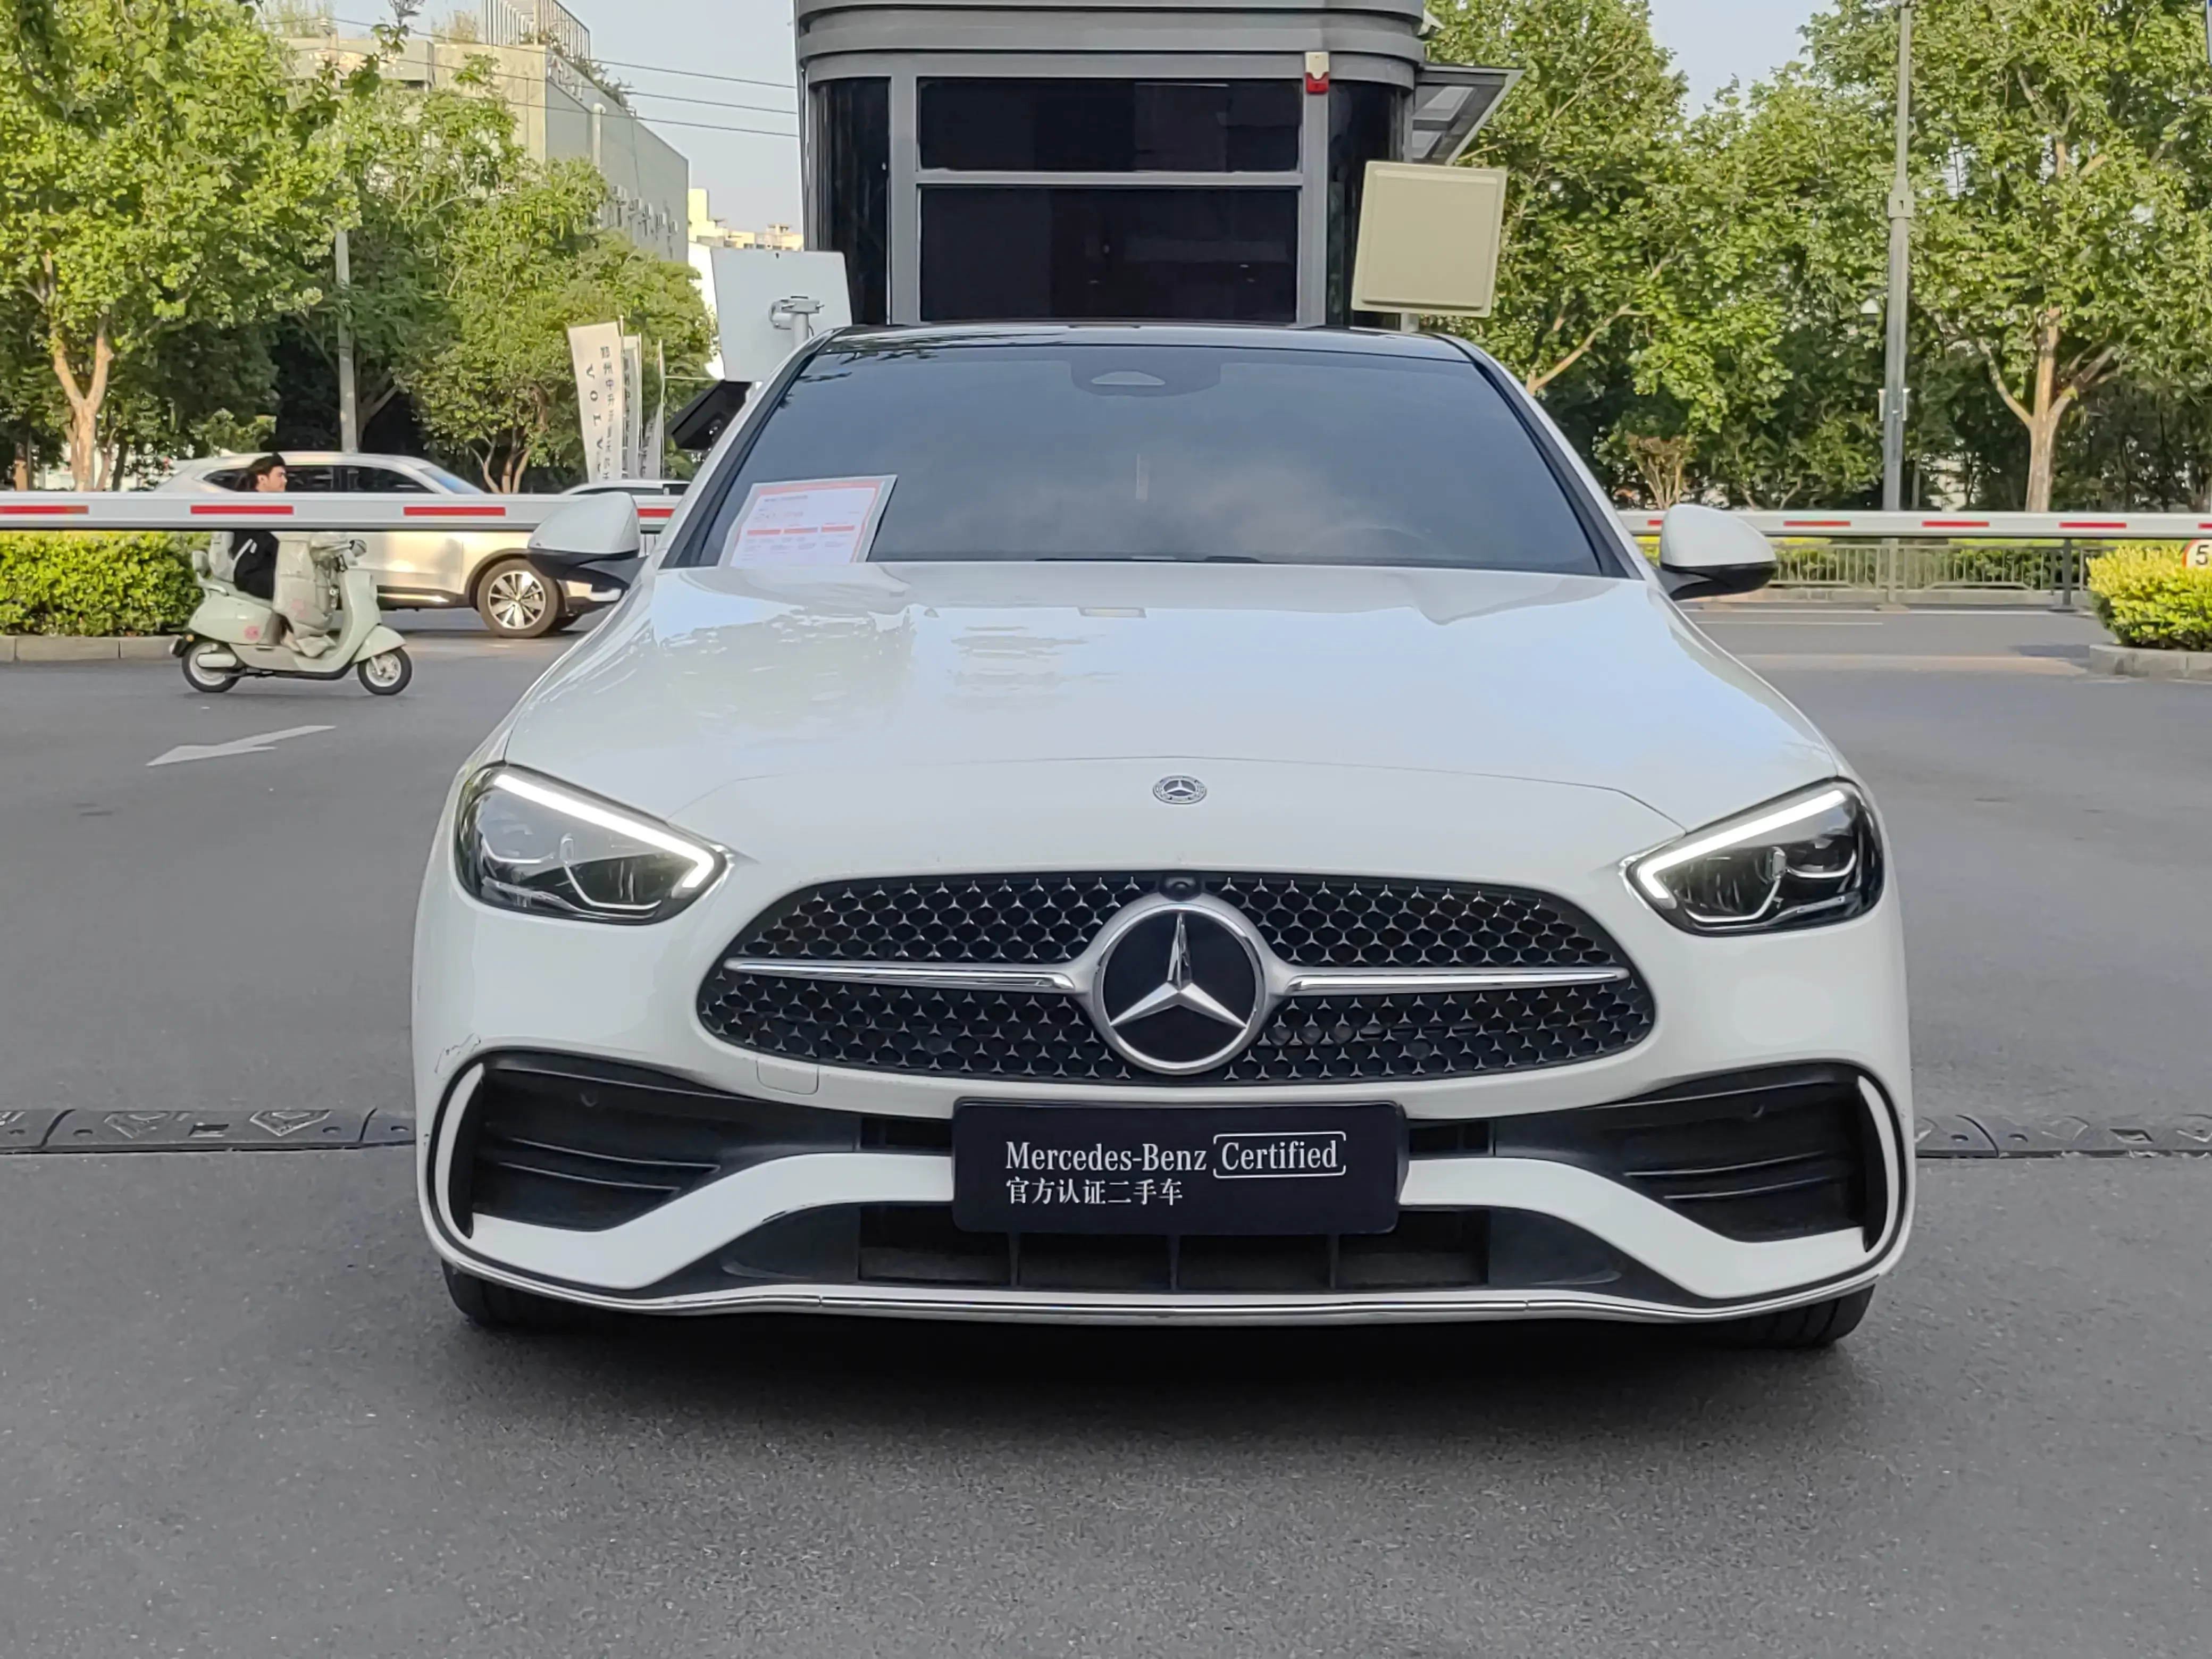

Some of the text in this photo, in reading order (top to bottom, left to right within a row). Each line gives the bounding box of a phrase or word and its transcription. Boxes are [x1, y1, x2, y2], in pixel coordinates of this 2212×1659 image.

[2195, 544, 2209, 565] 5
[1006, 1140, 1338, 1171] Mercedes-Benz Certified
[1006, 1176, 1183, 1206] 官方认证二手车
